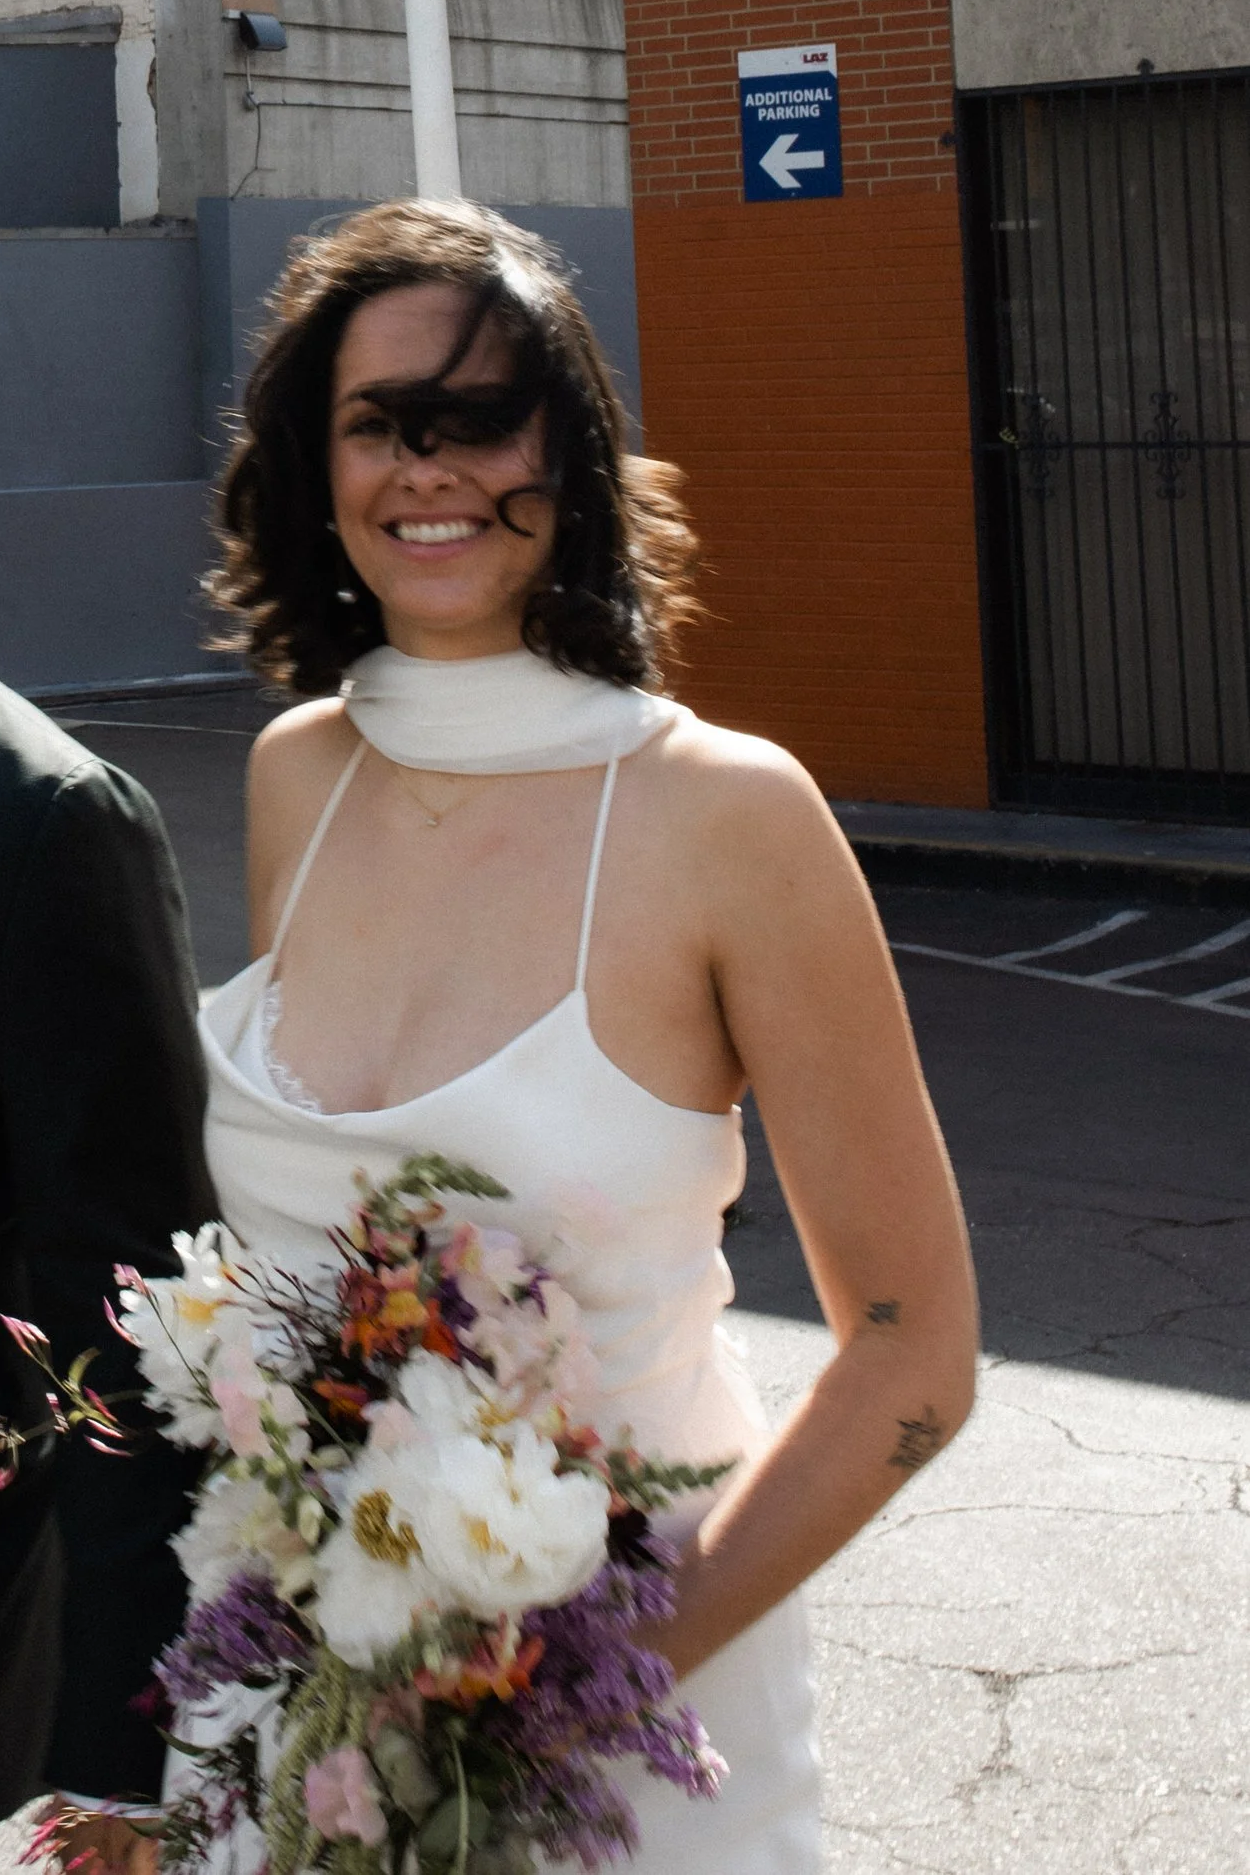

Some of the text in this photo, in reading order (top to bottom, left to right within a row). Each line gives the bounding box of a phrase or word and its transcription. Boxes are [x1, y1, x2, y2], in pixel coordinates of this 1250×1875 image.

[803, 52, 829, 64] LAZ
[745, 88, 832, 107] ADDITIONAL
[758, 104, 820, 121] PARKING
